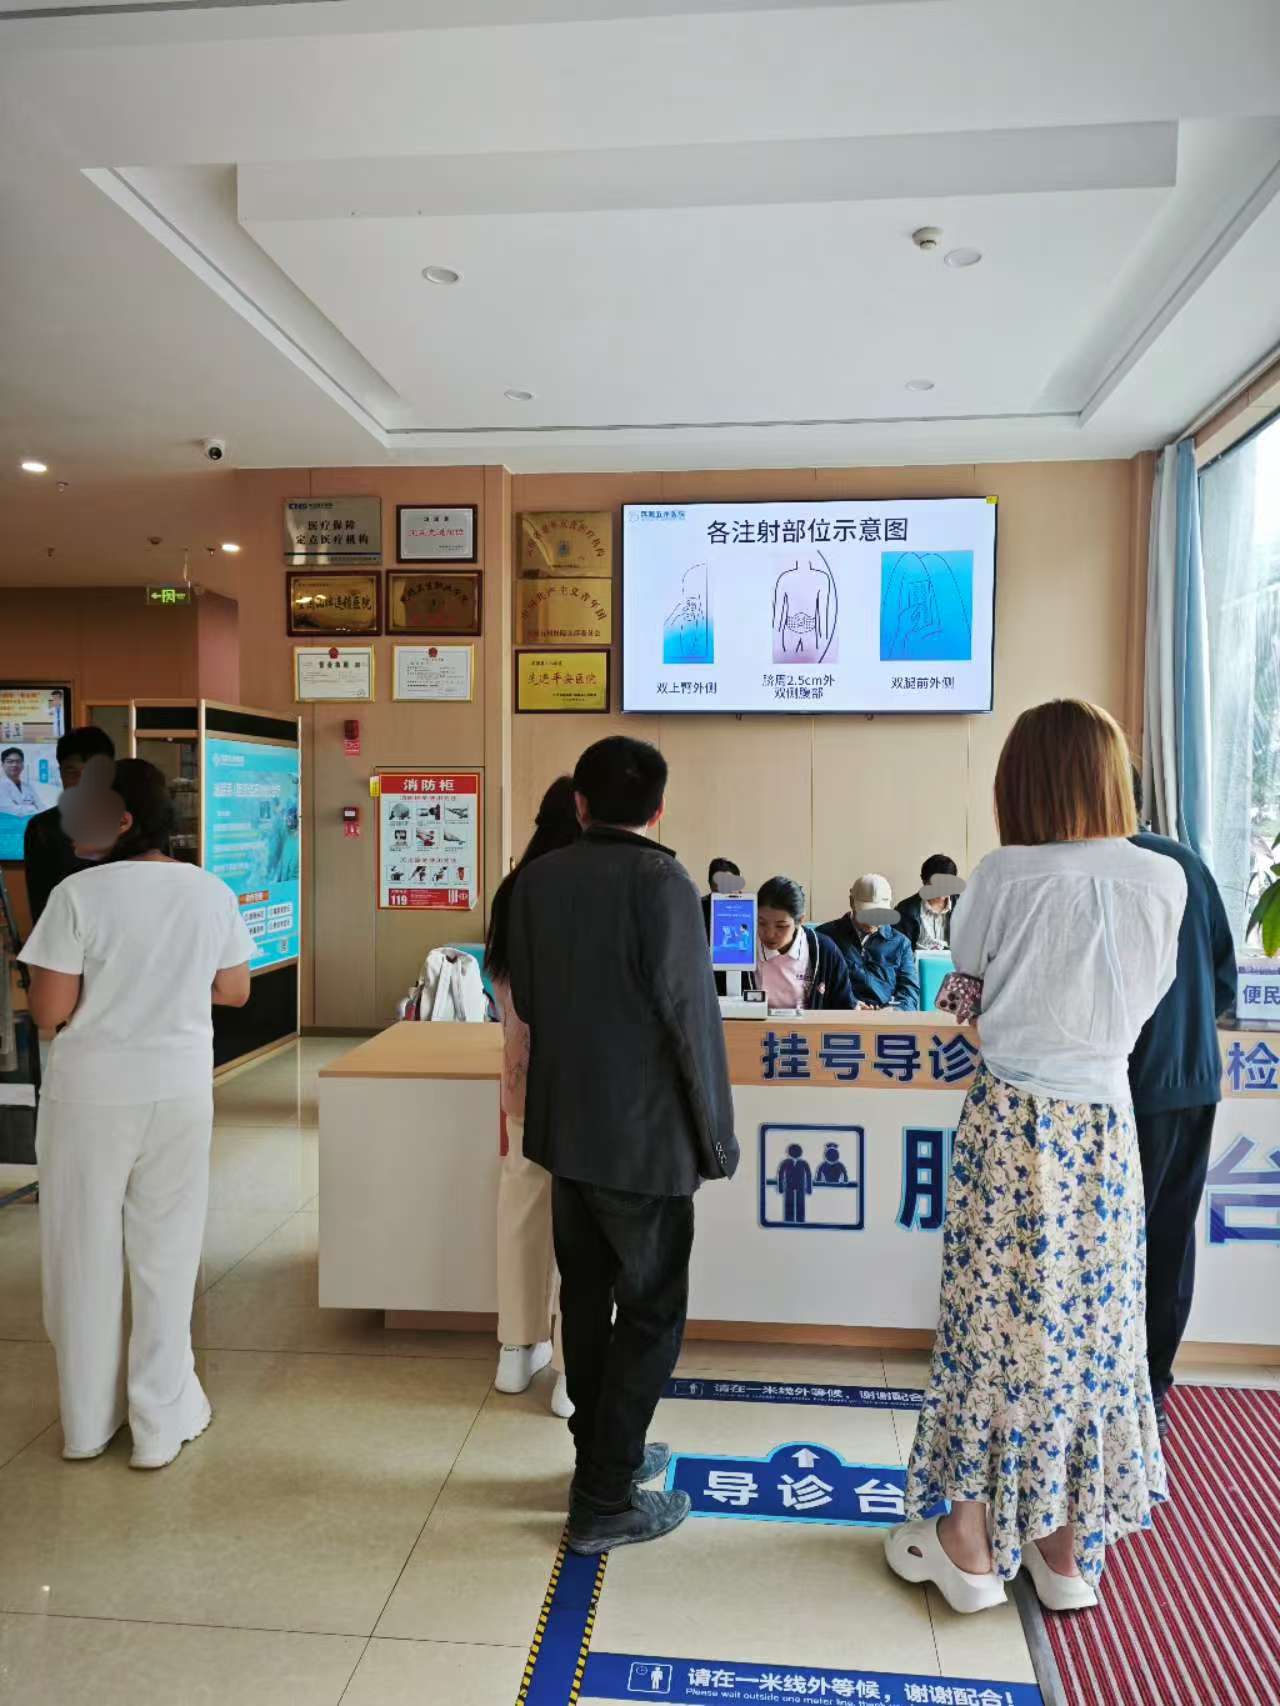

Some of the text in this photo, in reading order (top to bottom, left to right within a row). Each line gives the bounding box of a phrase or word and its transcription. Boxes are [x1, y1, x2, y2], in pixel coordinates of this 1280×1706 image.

[307, 519, 356, 531] 医疗保障
[706, 517, 909, 545] 各注射部位示意图
[295, 533, 369, 545] 定点医疗机构
[527, 671, 598, 687] 先进平安医院
[891, 676, 955, 690] 双腿前外侧
[774, 686, 824, 700] 双侧腹部
[403, 778, 455, 791] 消防柜
[390, 894, 408, 906] 119
[1243, 984, 1280, 1006] 便民
[762, 1031, 1280, 1091] 挂号导诊 检
[703, 1470, 906, 1516] 导诊台
[685, 1687, 719, 1698] Please
[720, 1690, 741, 1699] wait
[743, 1692, 780, 1702] outside
[782, 1695, 801, 1703] one
